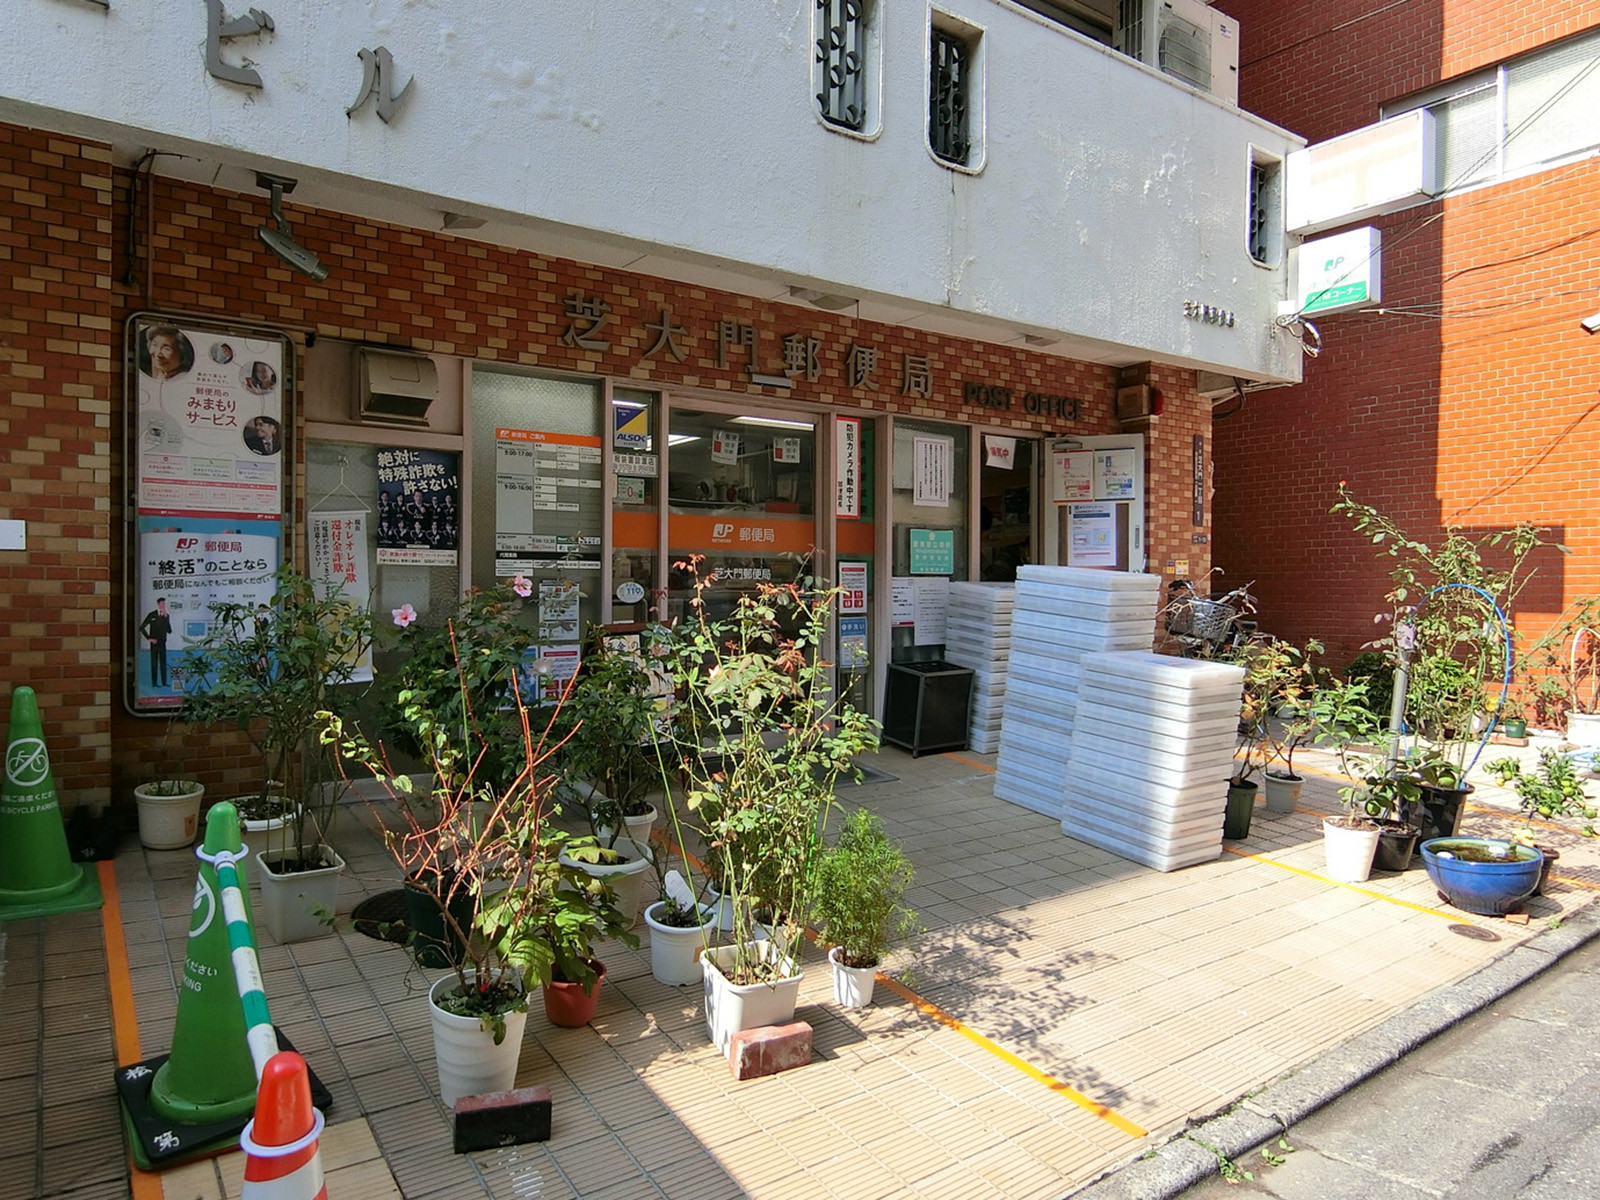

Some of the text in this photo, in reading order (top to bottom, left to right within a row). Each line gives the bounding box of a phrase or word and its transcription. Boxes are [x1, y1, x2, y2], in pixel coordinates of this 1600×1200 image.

[562, 292, 934, 400] 芝大門郵便局
[196, 387, 230, 397] 郵便局の
[963, 381, 1084, 420] POST OFFICE
[187, 396, 237, 413] みまもり
[186, 411, 238, 427] サービス
[617, 433, 646, 442] ALSOK
[377, 450, 420, 467] 絶対に
[378, 463, 445, 483] 特殊詐欺を
[846, 423, 854, 513] 防犯カメラ作動中です
[739, 528, 774, 542] 郵便局
[204, 541, 242, 552] 郵便局
[331, 520, 344, 573] 還付金詐欺
[345, 520, 357, 583] オレオレ詐欺
[714, 567, 771, 580] 芝大門郵便局
